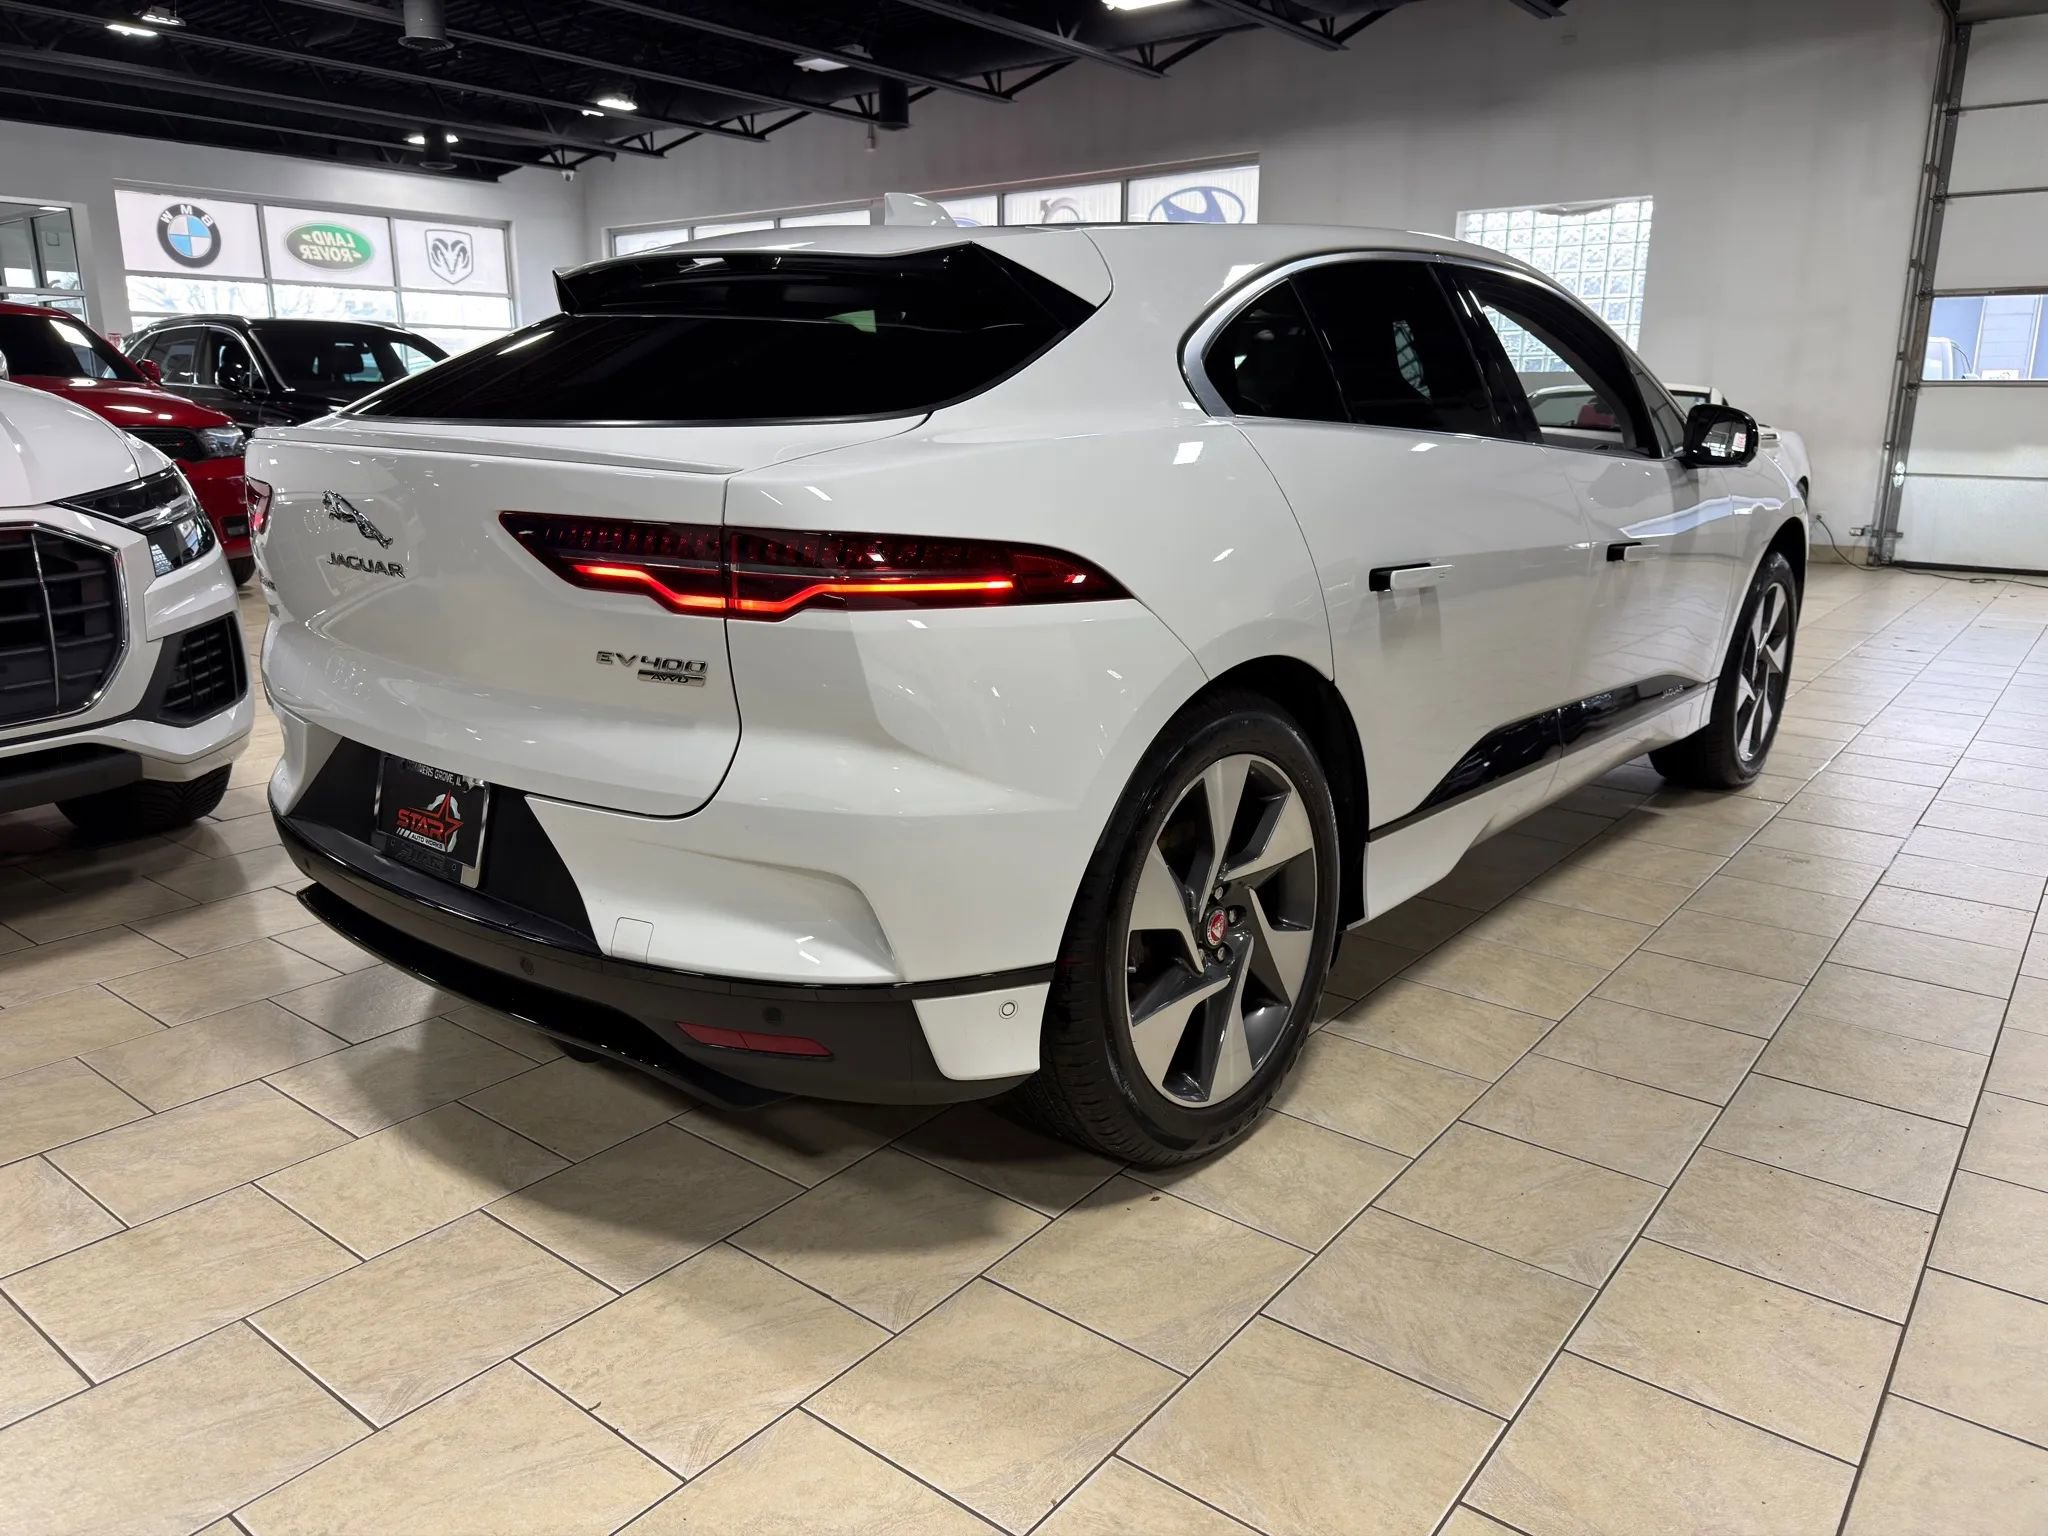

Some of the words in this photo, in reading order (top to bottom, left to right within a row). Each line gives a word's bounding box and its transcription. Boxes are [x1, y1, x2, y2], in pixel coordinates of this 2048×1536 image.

[327, 552, 406, 578] JAGUAR
[596, 650, 708, 675] EV400
[651, 672, 689, 683] AWD
[397, 808, 444, 840] STAR
[411, 833, 425, 843] AUTO
[425, 839, 443, 850] WORKS
